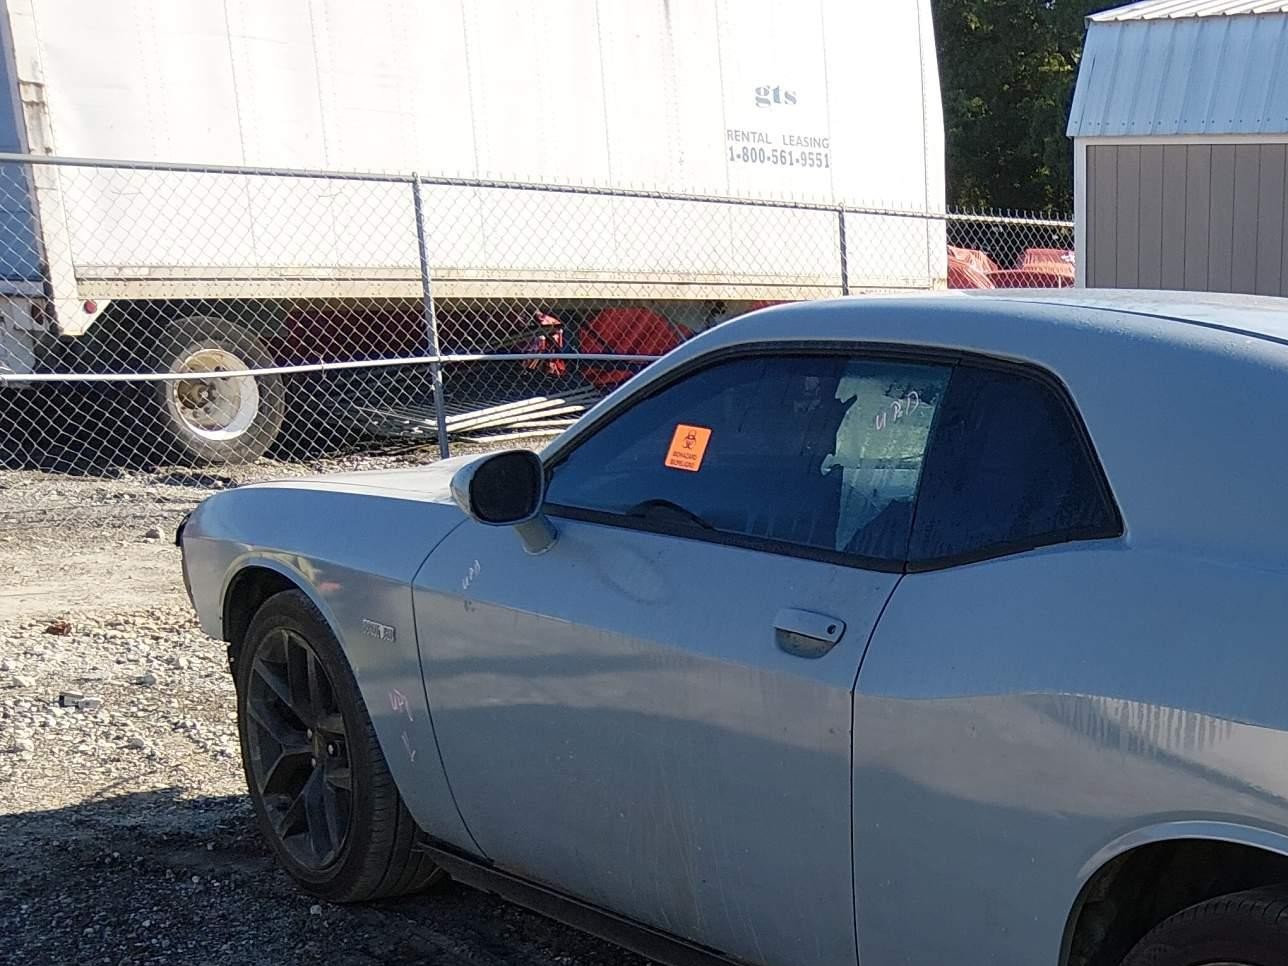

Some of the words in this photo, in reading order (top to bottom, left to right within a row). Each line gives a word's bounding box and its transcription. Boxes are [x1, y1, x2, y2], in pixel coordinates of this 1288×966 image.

[755, 85, 797, 109] gts
[726, 129, 773, 145] RENTAL
[782, 134, 830, 149] LEASING
[728, 146, 831, 169] 1-800-561-9551
